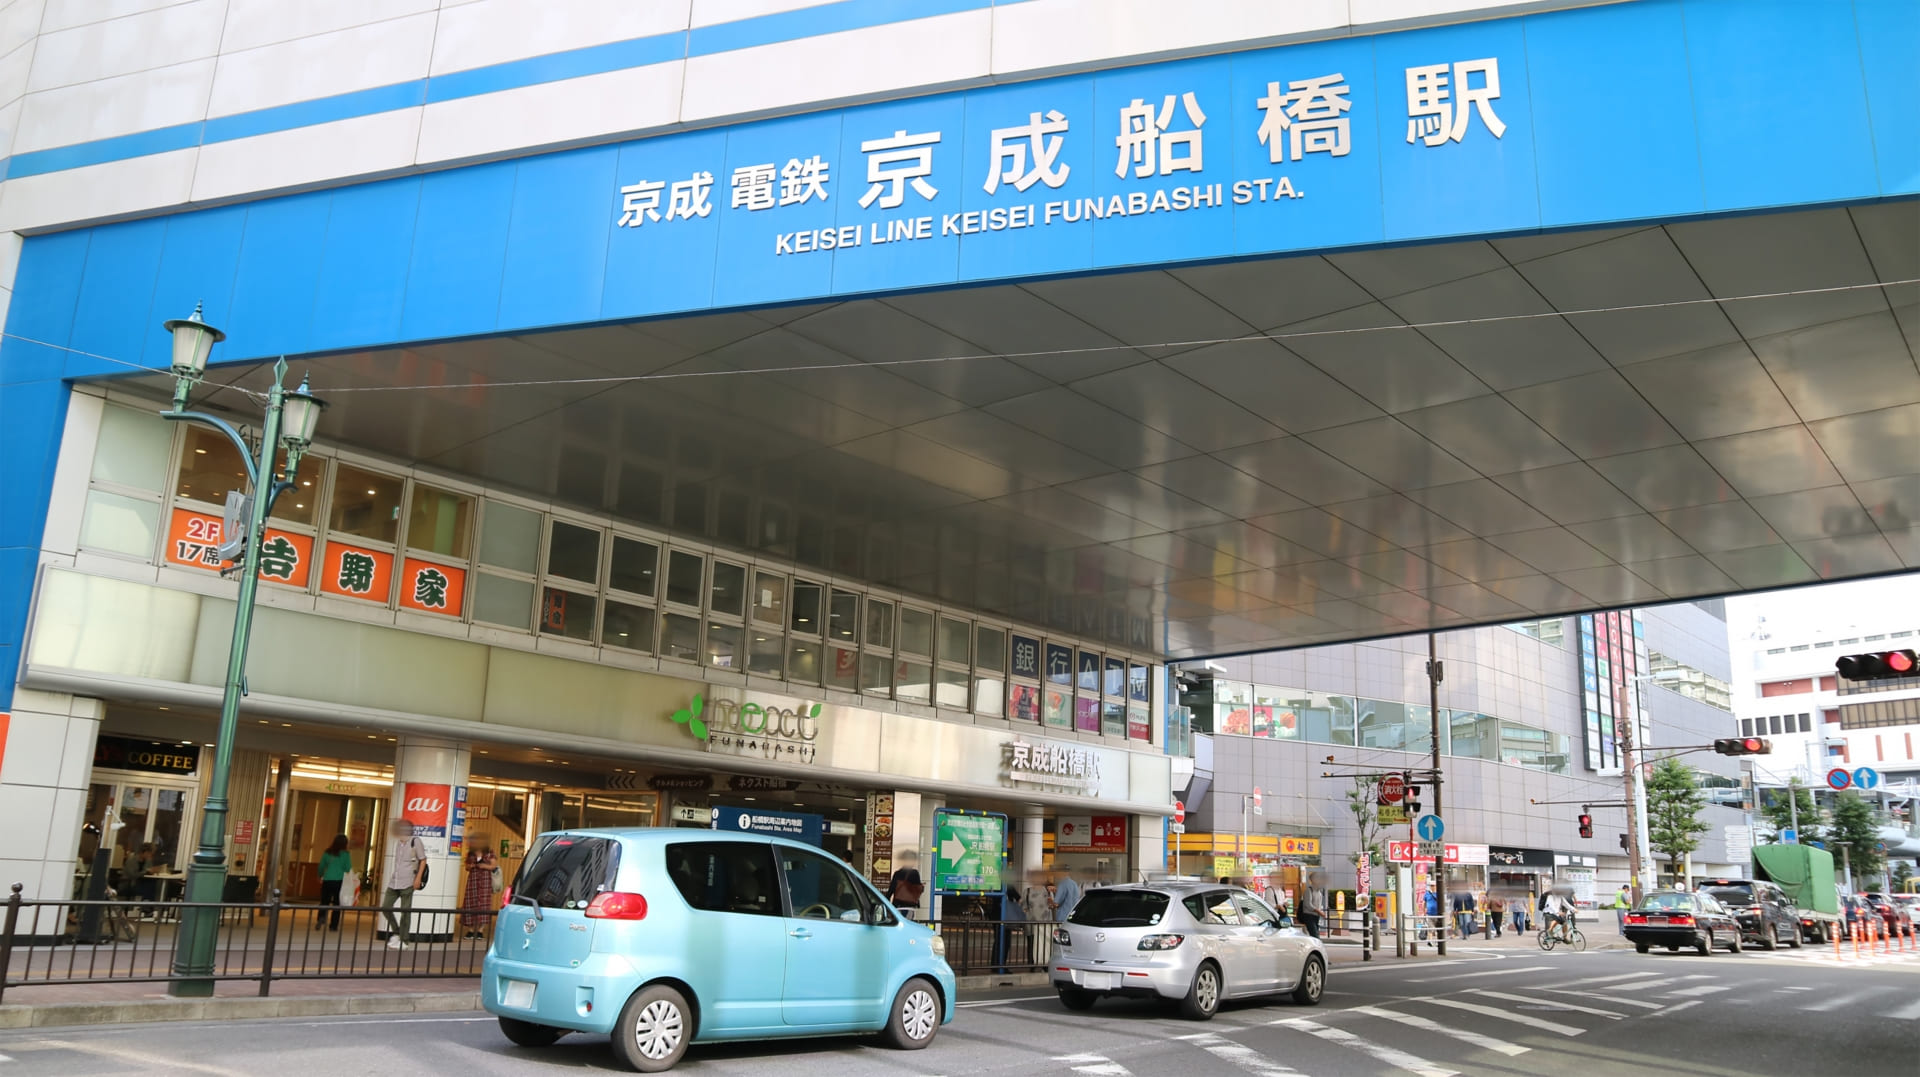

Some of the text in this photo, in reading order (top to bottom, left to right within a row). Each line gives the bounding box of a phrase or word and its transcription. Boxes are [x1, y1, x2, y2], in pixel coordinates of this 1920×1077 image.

[857, 57, 1507, 210] 京成船橋駅
[775, 175, 1305, 256] KEISEI LINE KEISEI FUNABASHI STA.
[186, 518, 221, 541] 2F
[1016, 642, 1147, 698] 銀行 ATM
[128, 751, 193, 770] COFFEE
[1012, 741, 1100, 780] 京成船橋駅
[407, 796, 445, 813] au
